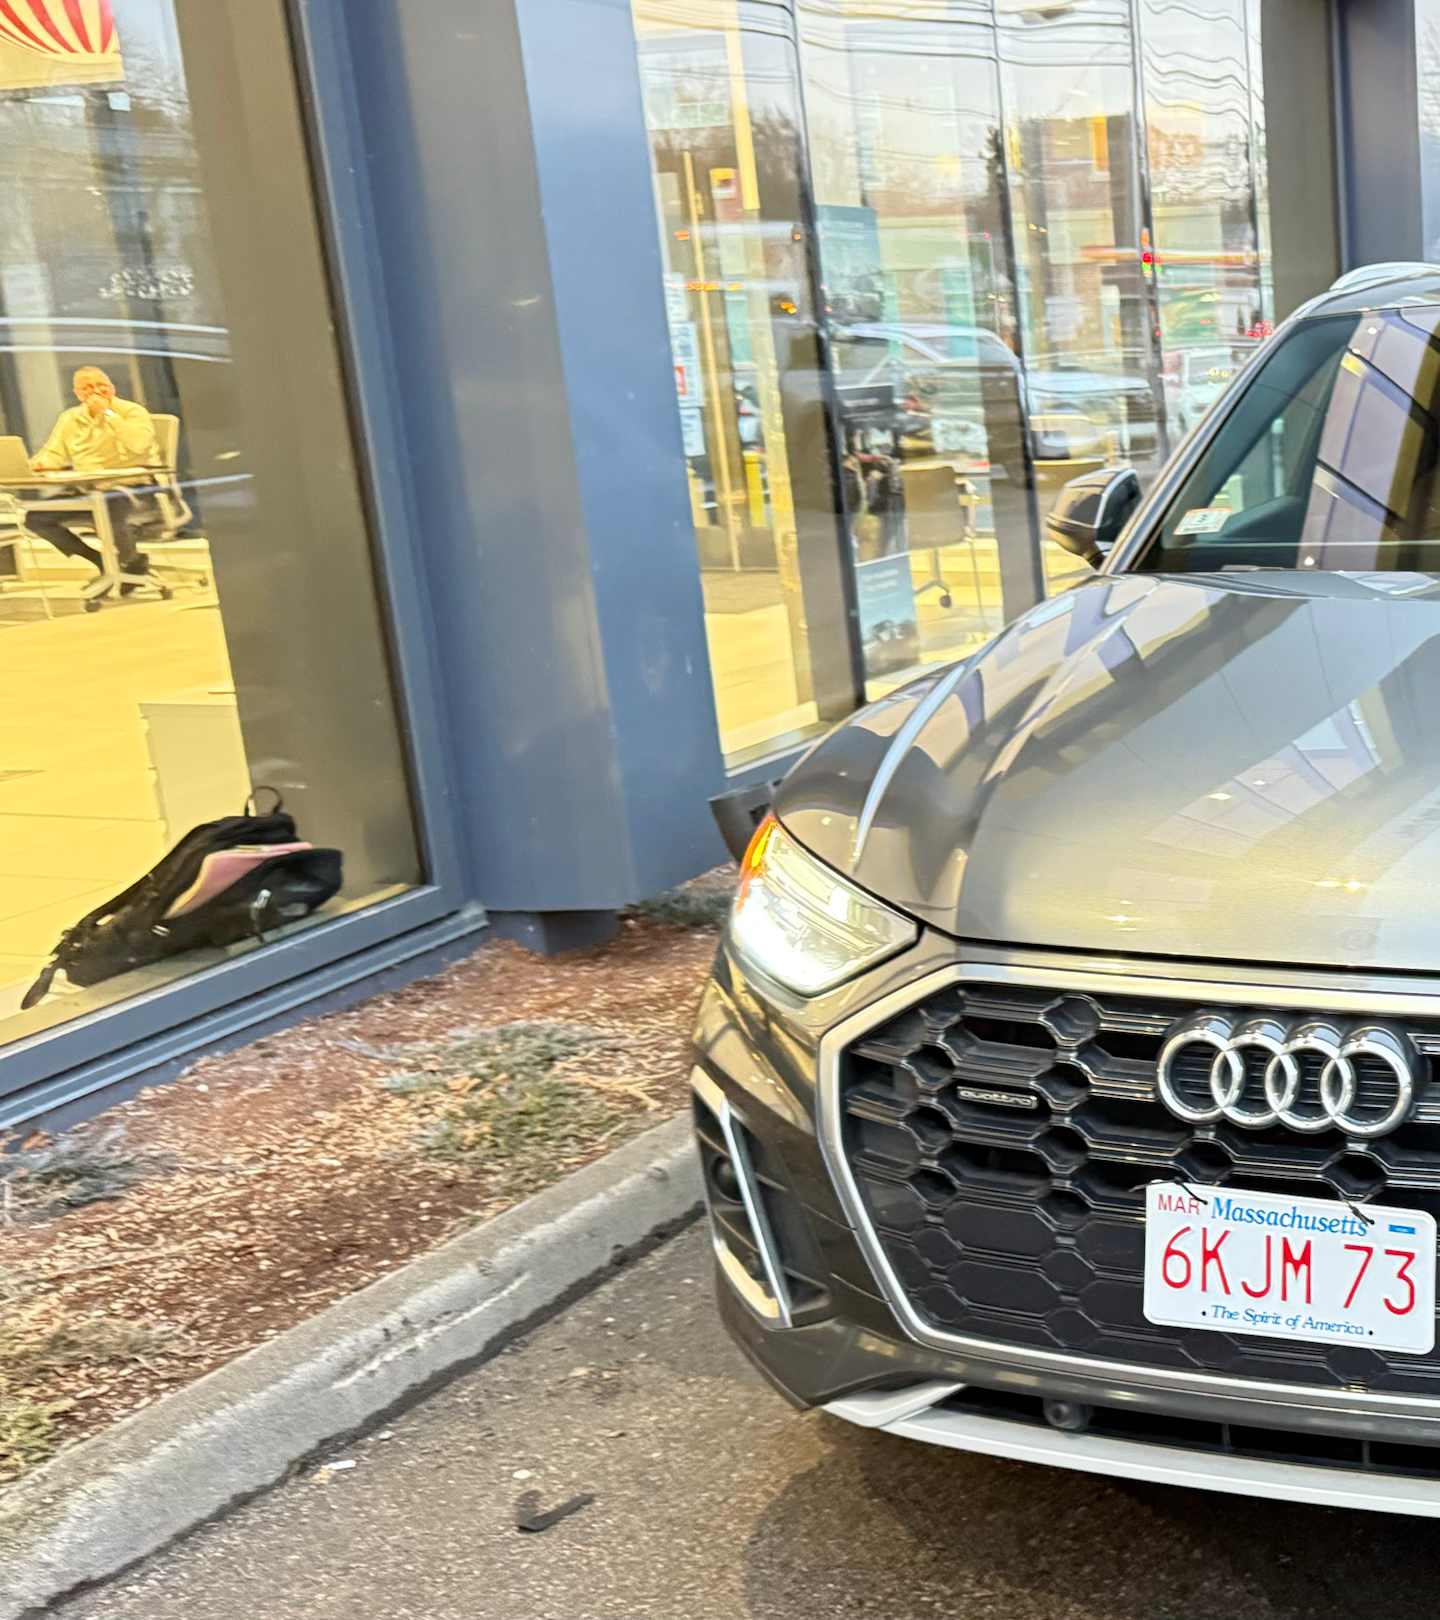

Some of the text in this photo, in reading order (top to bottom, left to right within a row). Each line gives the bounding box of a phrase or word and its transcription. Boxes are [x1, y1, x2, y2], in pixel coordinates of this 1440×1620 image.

[1157, 1193, 1201, 1215] MAR
[1210, 1196, 1369, 1238] Massachusetts
[1161, 1225, 1417, 1316] 6KJM 73
[1211, 1305, 1365, 1336] The Spirit of America
